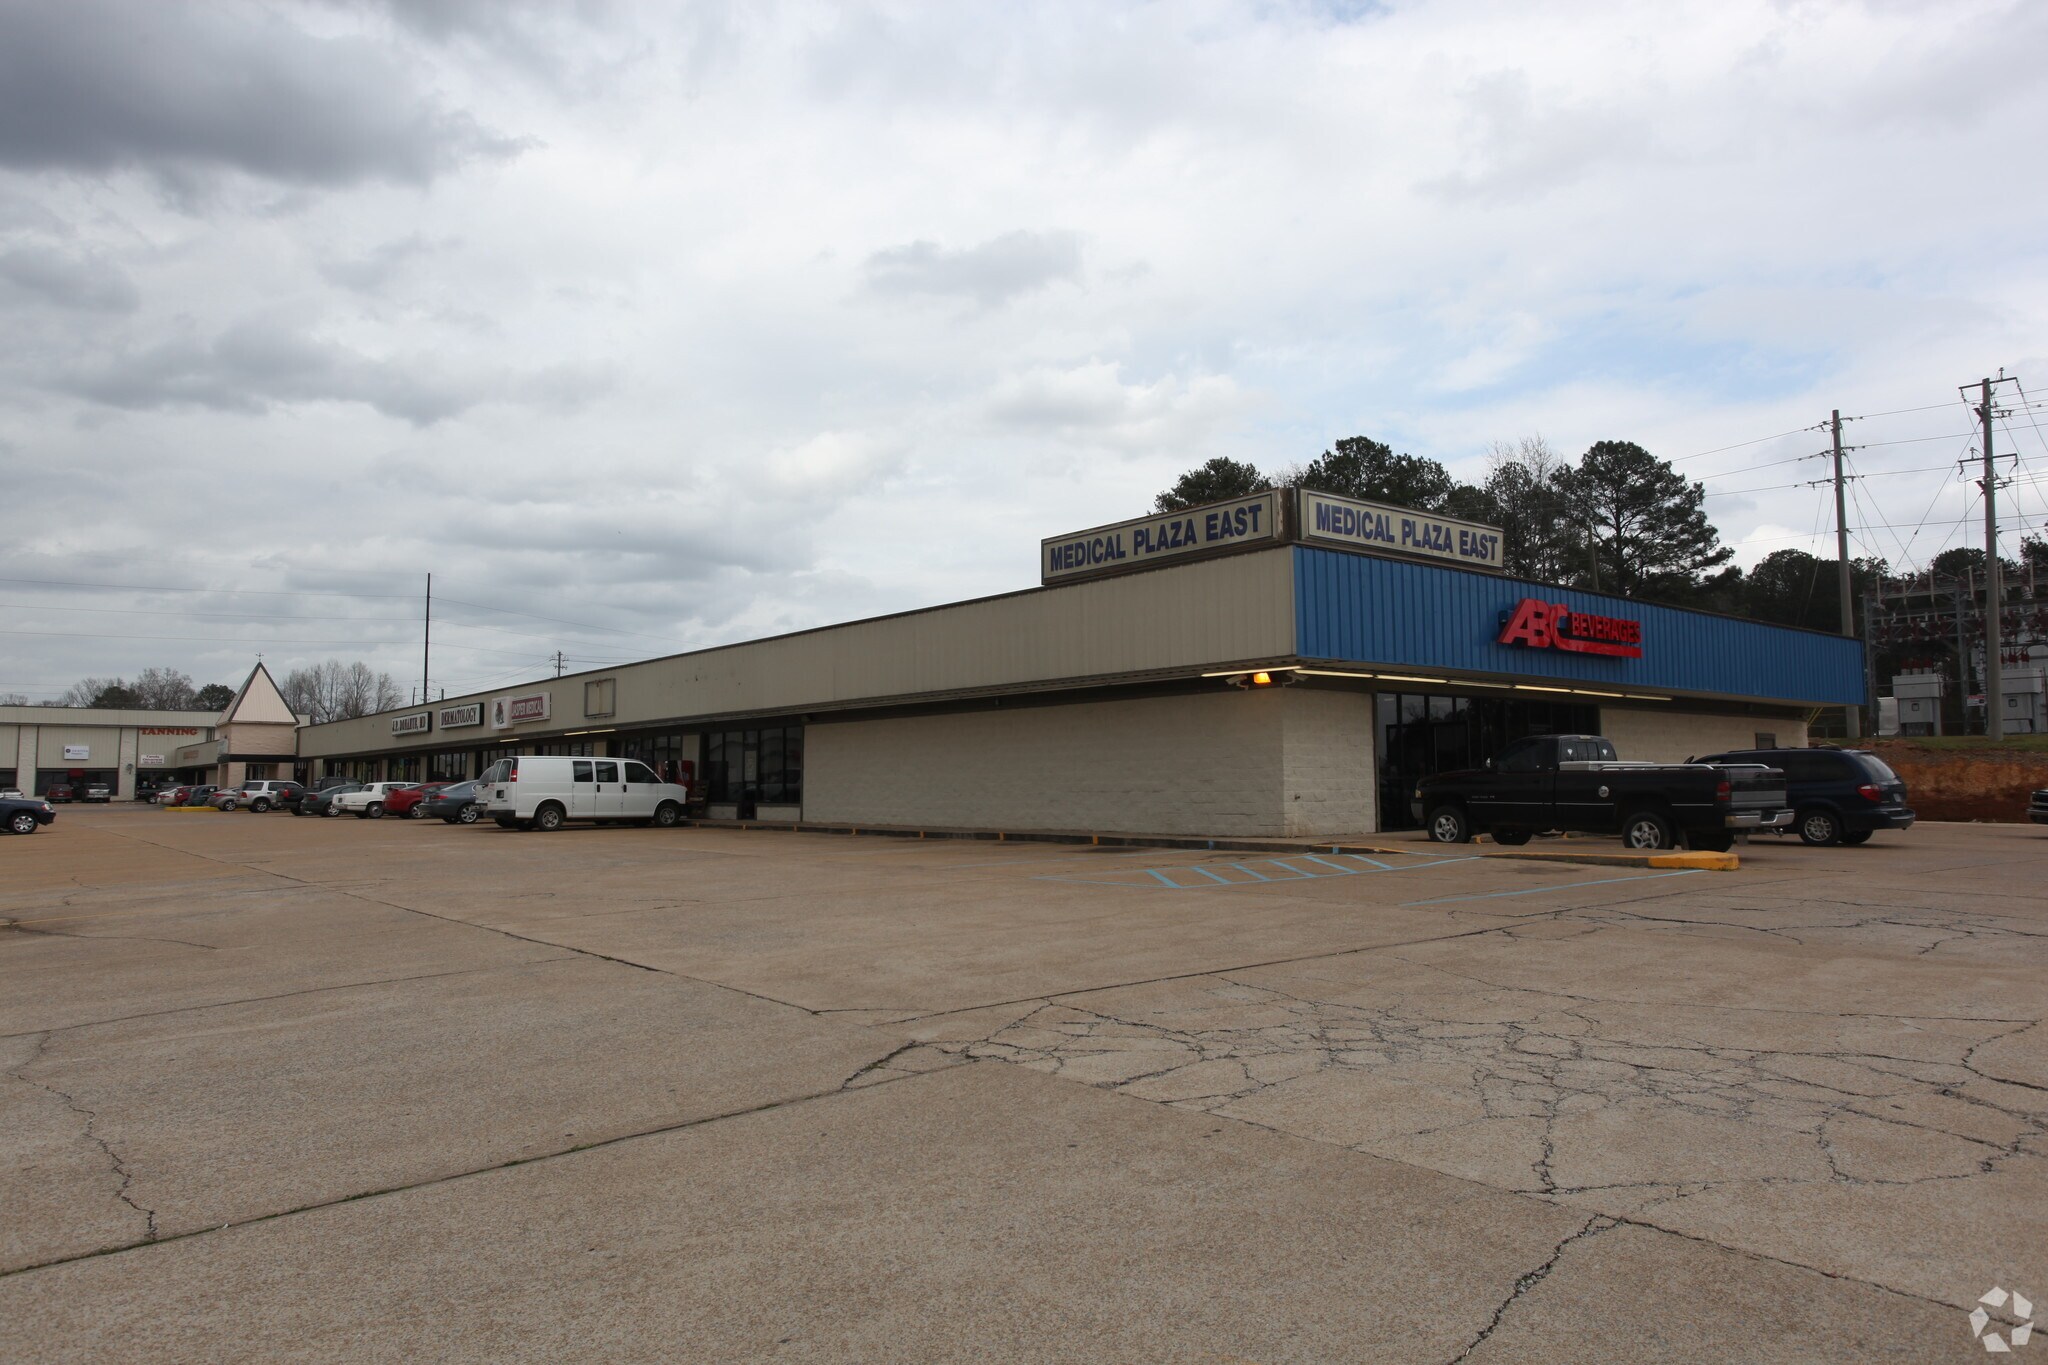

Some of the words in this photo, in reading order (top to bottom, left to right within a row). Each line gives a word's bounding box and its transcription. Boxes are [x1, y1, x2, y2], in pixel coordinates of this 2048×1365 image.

[1050, 533, 1126, 572] MEDICAL
[1134, 518, 1197, 556] PLAZA
[1206, 504, 1262, 542] EAST
[1316, 502, 1395, 543] MEDICAL
[1402, 518, 1453, 553] PLAZA
[1459, 530, 1498, 561] EAST
[1497, 598, 1569, 651] ABC
[1571, 612, 1641, 644] BEVERAGES
[441, 707, 477, 726] DERMATOLOGY
[526, 699, 543, 714] MEDICAL
[141, 727, 198, 736] TANNING
